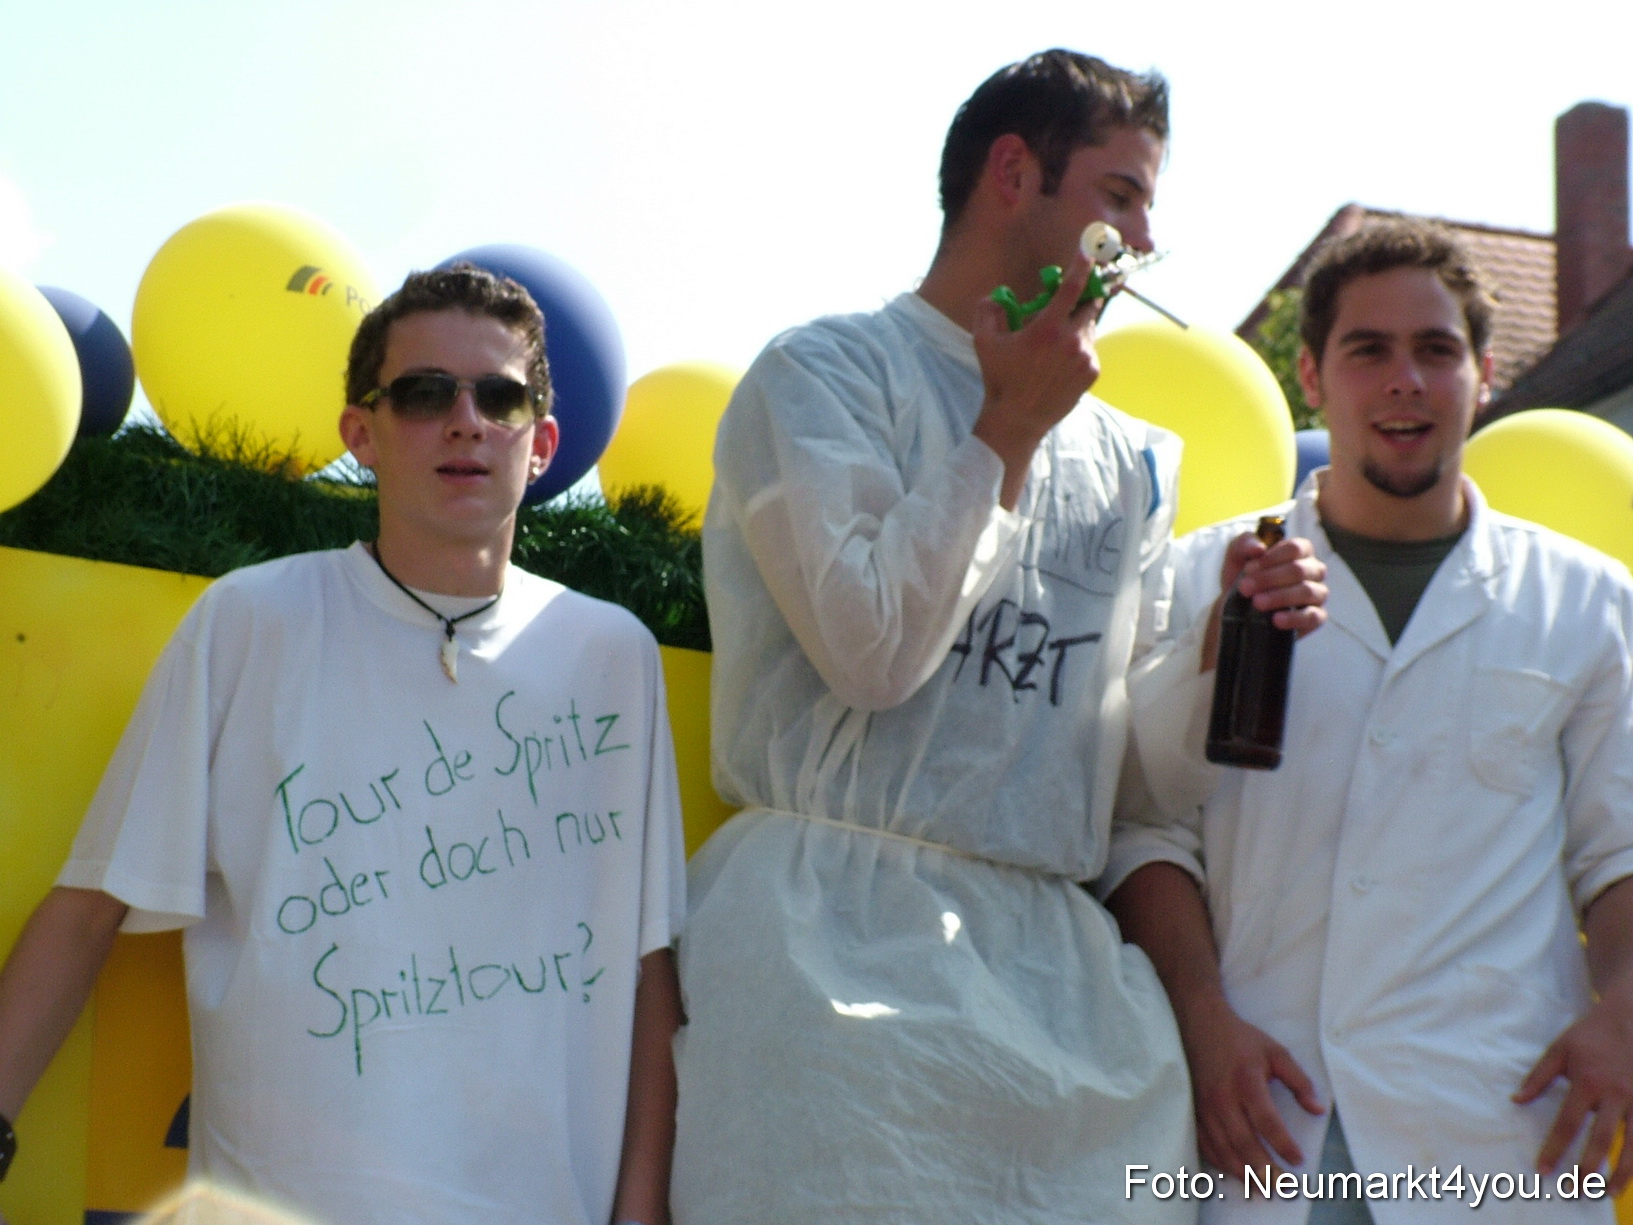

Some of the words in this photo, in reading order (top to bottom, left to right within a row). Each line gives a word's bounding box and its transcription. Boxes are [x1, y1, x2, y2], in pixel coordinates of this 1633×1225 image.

[274, 763, 402, 853] Tour
[424, 719, 475, 796] de
[494, 690, 632, 807] Spritz
[277, 857, 390, 934] oder
[419, 808, 531, 889] doch
[556, 811, 623, 853] nur
[307, 921, 606, 1077] Spritztour?
